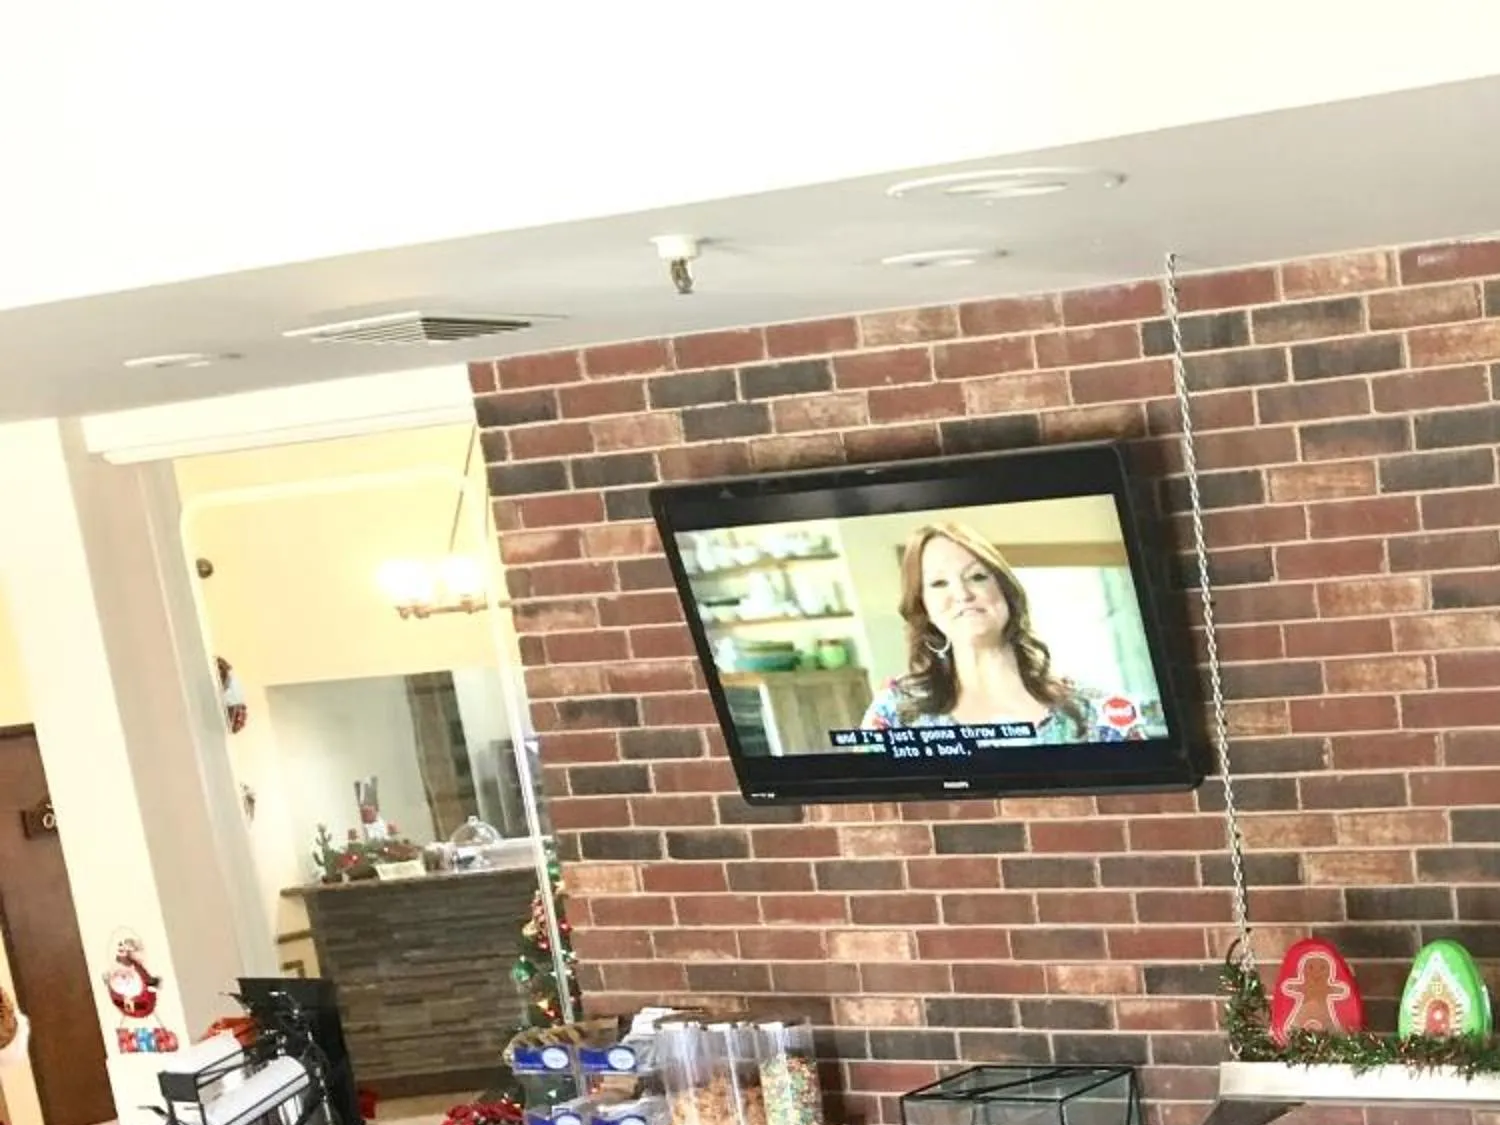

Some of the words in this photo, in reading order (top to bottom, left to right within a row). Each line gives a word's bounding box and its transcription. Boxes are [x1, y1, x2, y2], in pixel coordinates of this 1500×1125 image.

[888, 729, 916, 745] just
[919, 730, 956, 744] gonna
[960, 727, 996, 739] throw
[1000, 724, 1032, 737] them
[892, 745, 920, 759] into
[924, 745, 933, 757] a
